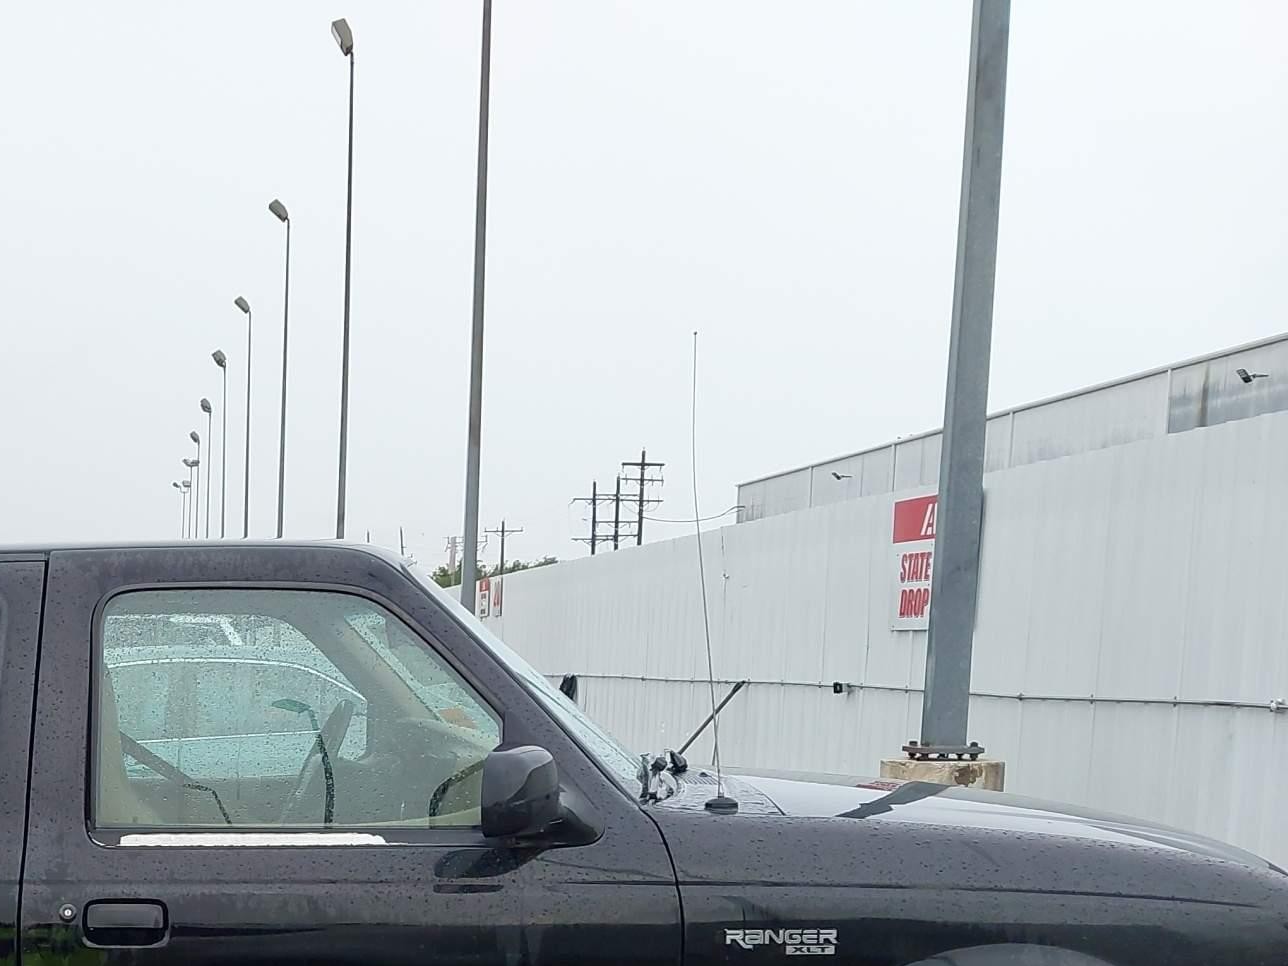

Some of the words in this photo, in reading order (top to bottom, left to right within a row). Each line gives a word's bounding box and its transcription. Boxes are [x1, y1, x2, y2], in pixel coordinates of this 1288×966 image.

[900, 552, 932, 583] STATE
[899, 588, 930, 618] DROP
[724, 928, 838, 950] RANGER
[788, 945, 833, 954] XLT
